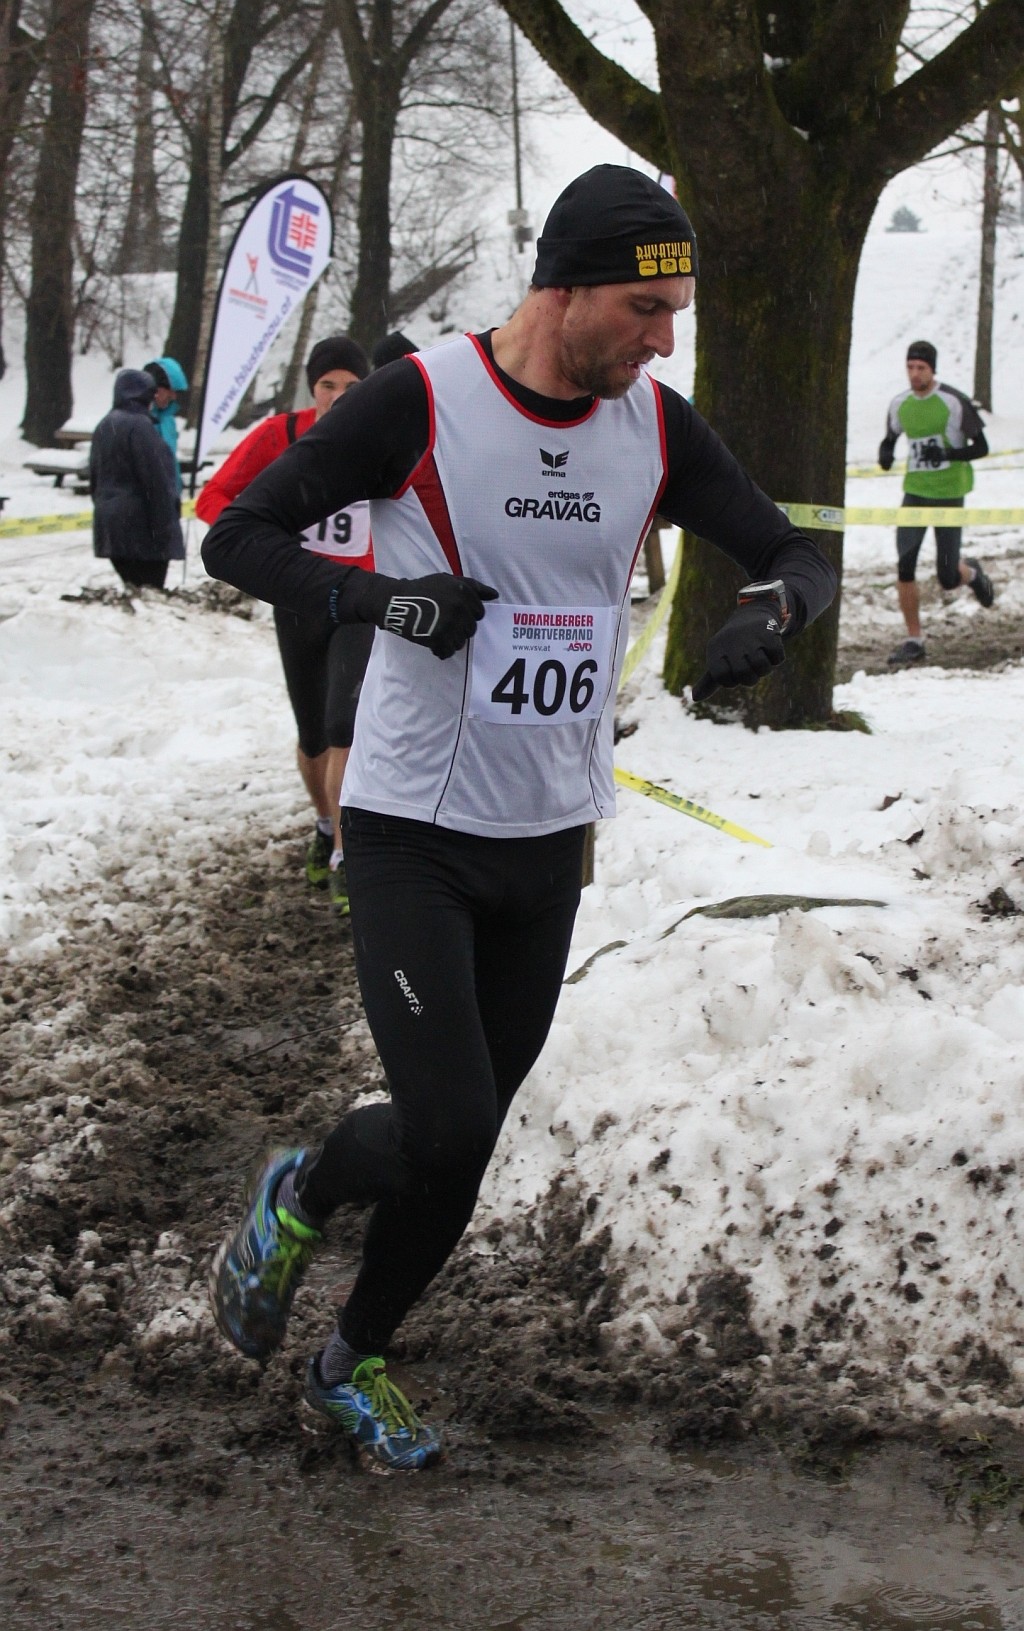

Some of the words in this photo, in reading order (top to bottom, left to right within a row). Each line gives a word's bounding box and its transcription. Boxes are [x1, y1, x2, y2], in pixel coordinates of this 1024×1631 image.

[635, 241, 692, 261] RHYATHLON
[541, 470, 566, 478] erima
[548, 490, 580, 500] erdgas
[504, 497, 601, 523] GRAVAG
[513, 613, 594, 627] VORARLBERGER
[512, 627, 593, 641] SPORTVERBAND
[512, 644, 551, 652] www.vsv.at
[491, 658, 598, 716] 406
[394, 969, 420, 1005] CRAFT
